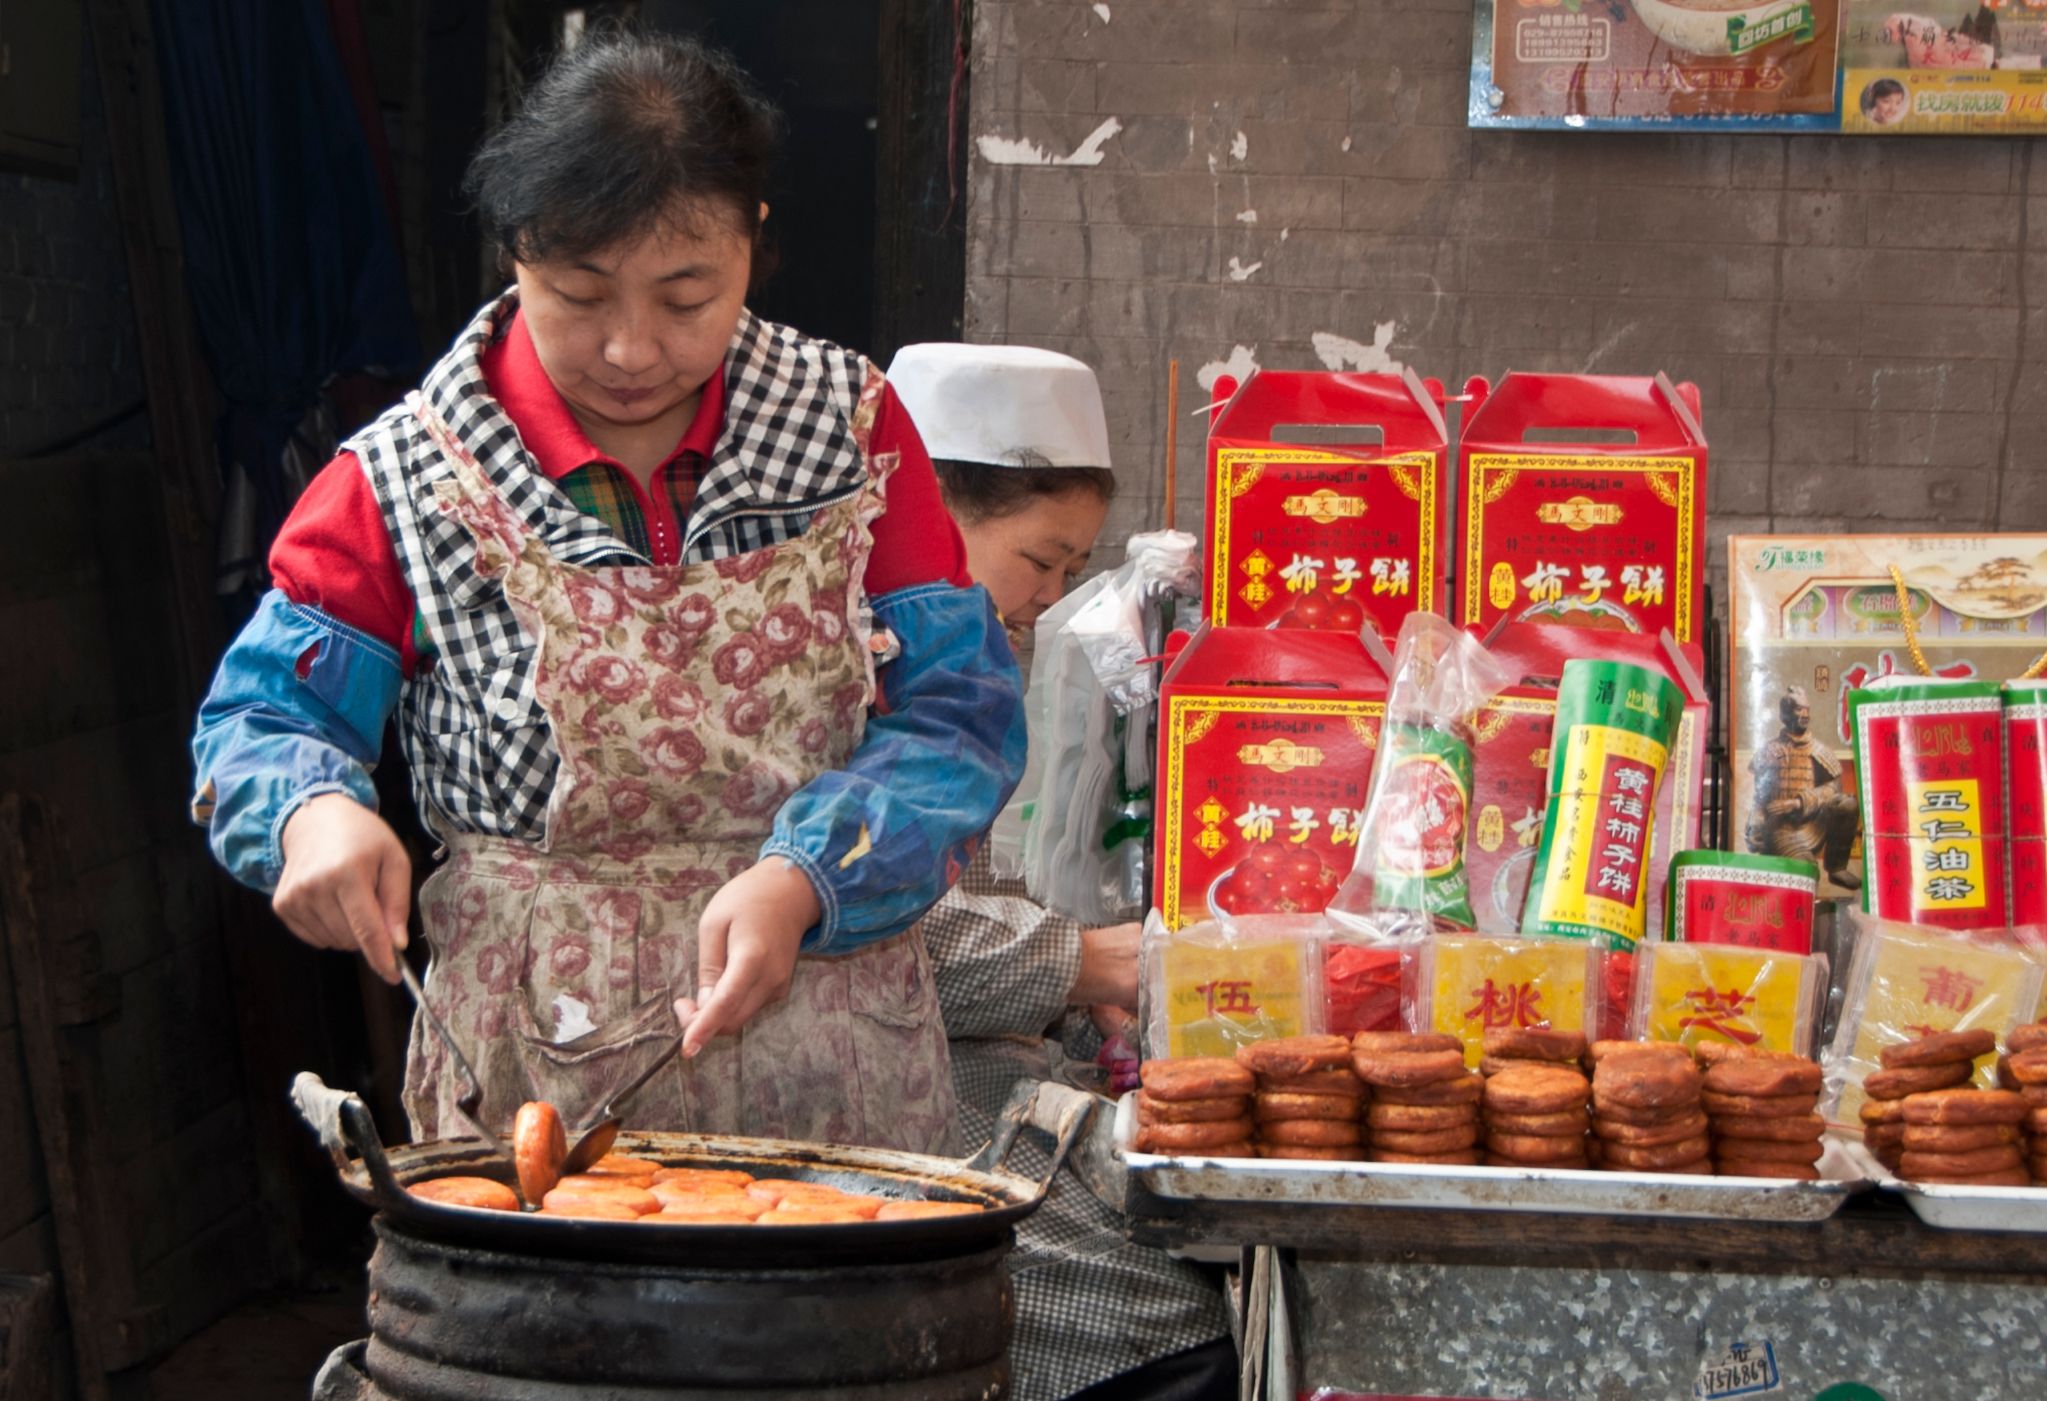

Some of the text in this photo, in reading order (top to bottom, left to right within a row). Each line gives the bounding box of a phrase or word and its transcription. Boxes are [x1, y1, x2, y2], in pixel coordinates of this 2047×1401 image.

[1538, 14, 1589, 27] 销售热线
[1597, 767, 1649, 896] 黄桂柿子饼
[1918, 790, 1975, 900] 五仁油茶
[1195, 980, 1263, 1017] 伍
[1464, 978, 1551, 1033] 桃
[1679, 988, 1762, 1044] 芝
